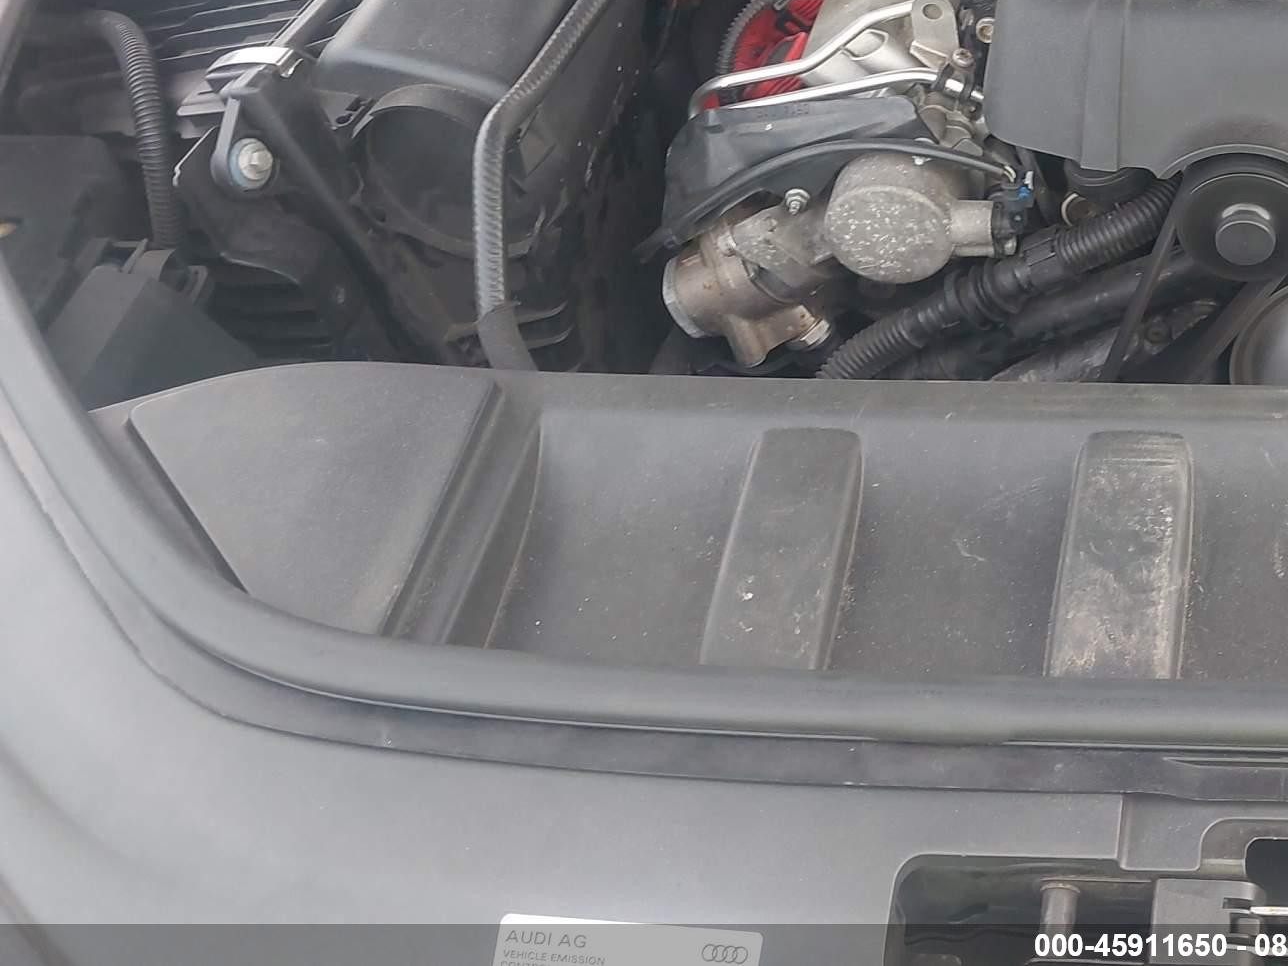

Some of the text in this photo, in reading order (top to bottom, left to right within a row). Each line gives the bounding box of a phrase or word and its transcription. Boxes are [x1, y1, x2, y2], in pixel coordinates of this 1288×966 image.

[505, 929, 587, 948] AUDI AG
[503, 950, 606, 966] VEHICLE EMISSION
